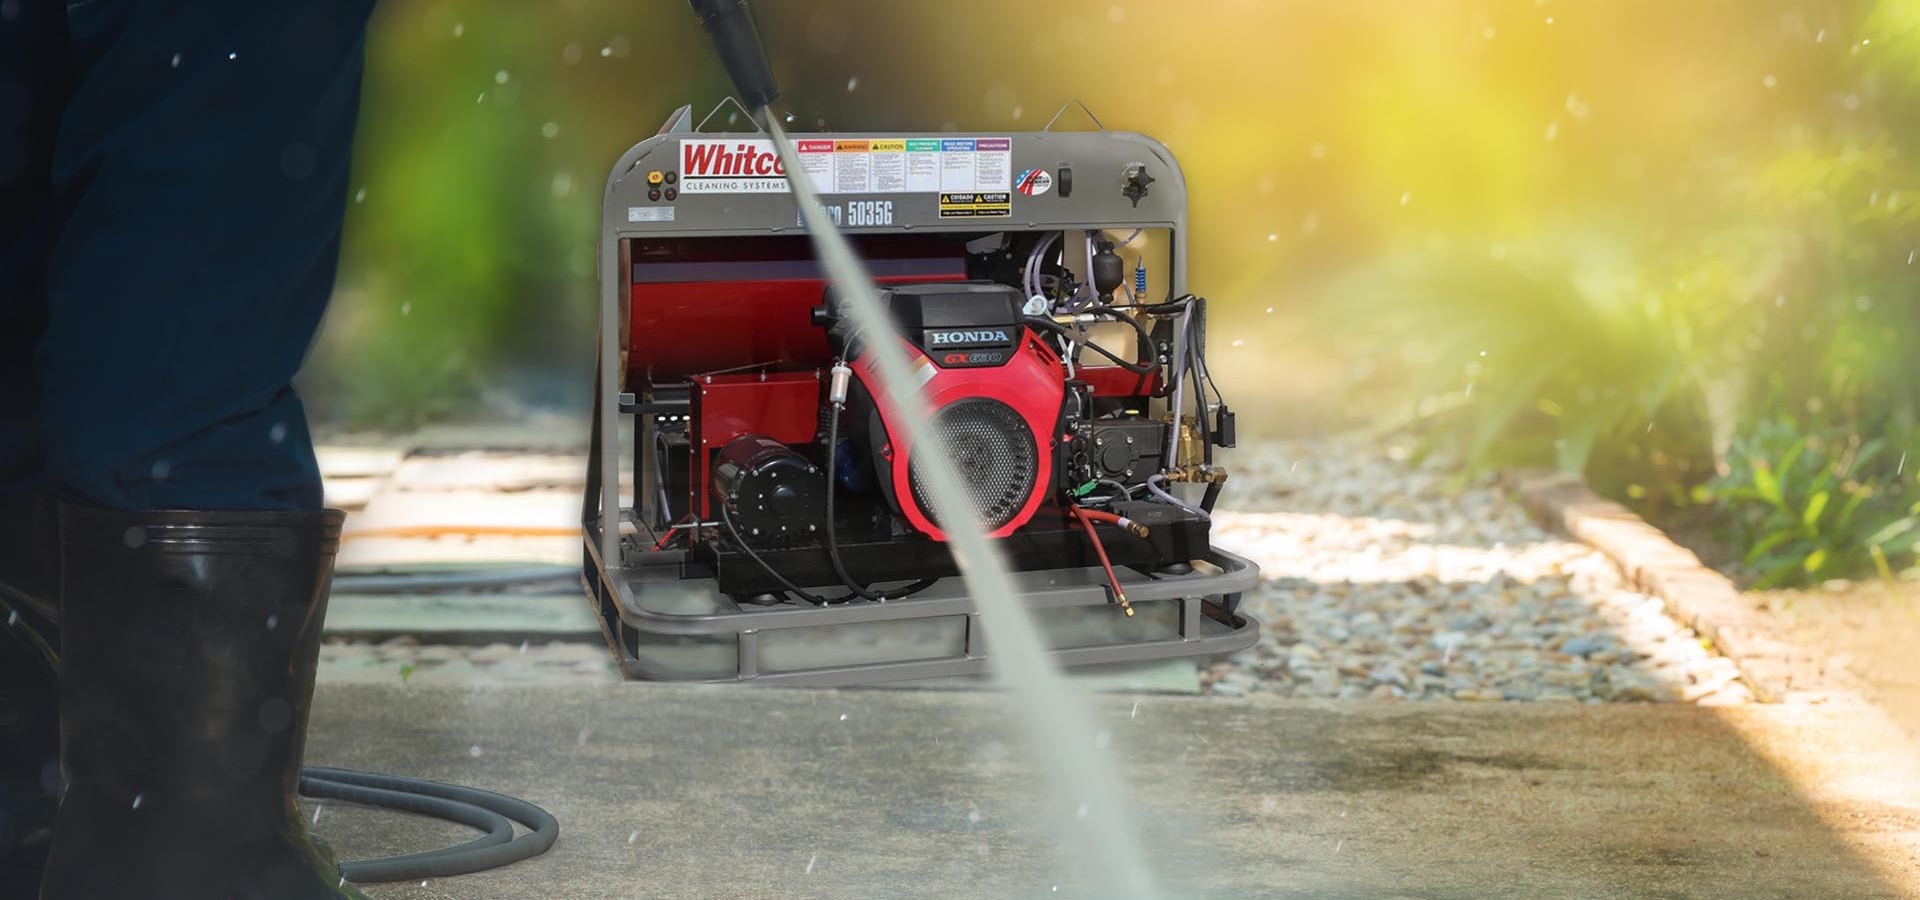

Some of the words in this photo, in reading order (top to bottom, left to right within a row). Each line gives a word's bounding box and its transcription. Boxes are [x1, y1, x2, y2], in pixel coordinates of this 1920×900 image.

[686, 182, 738, 190] CLEANING
[743, 182, 786, 190] SYSTEMS
[848, 200, 892, 226] 5035G
[932, 330, 1010, 344] HONDA
